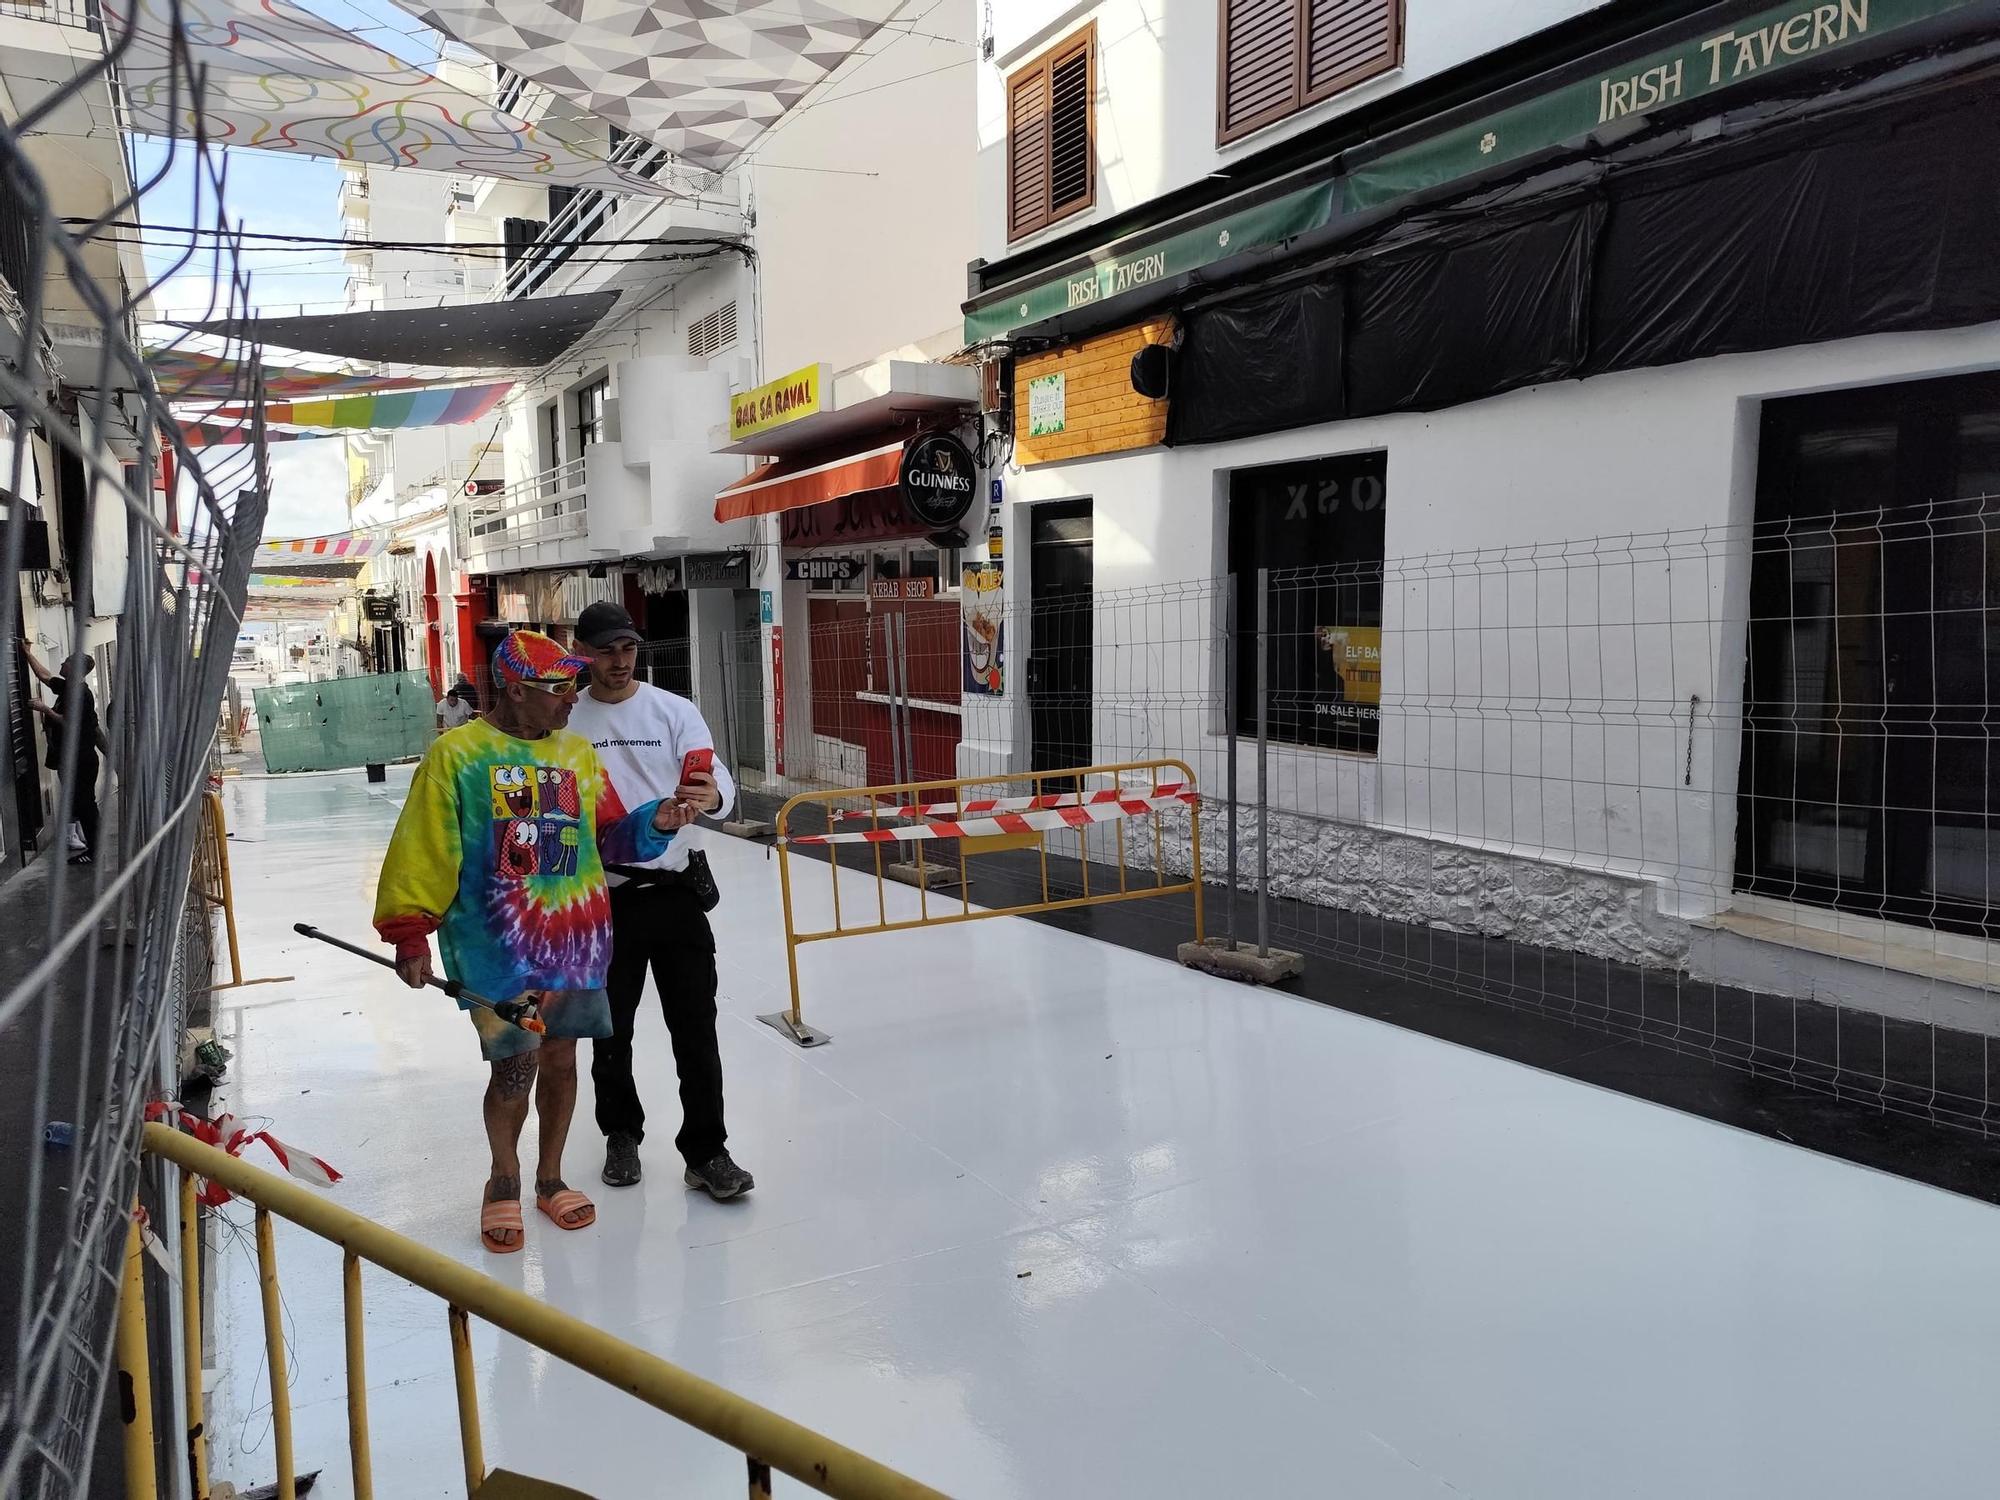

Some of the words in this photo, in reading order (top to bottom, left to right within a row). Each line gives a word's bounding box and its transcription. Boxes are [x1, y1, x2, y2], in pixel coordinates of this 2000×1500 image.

[1598, 58, 1683, 124] IRISH
[1700, 0, 1869, 85] TAVERN
[1067, 276, 1099, 308] IRISH
[1105, 251, 1165, 294] TAVERN
[735, 400, 757, 429] BAR
[760, 394, 774, 421] SA
[775, 379, 812, 415] RAVAL
[908, 469, 970, 492] GUINNESS
[993, 483, 1000, 497] R
[797, 561, 850, 579] CHIPS
[872, 581, 899, 598] KEBAB
[906, 580, 928, 598] SHOP
[963, 571, 1003, 592] NOODLES
[761, 594, 772, 612] HR
[1345, 646, 1363, 658] ELF
[1364, 647, 1381, 659] BA
[774, 647, 783, 764] PIZZA
[1315, 703, 1328, 714] ON
[1330, 705, 1355, 717] SALE
[1356, 707, 1381, 720] HERE
[610, 739, 662, 748] movement
